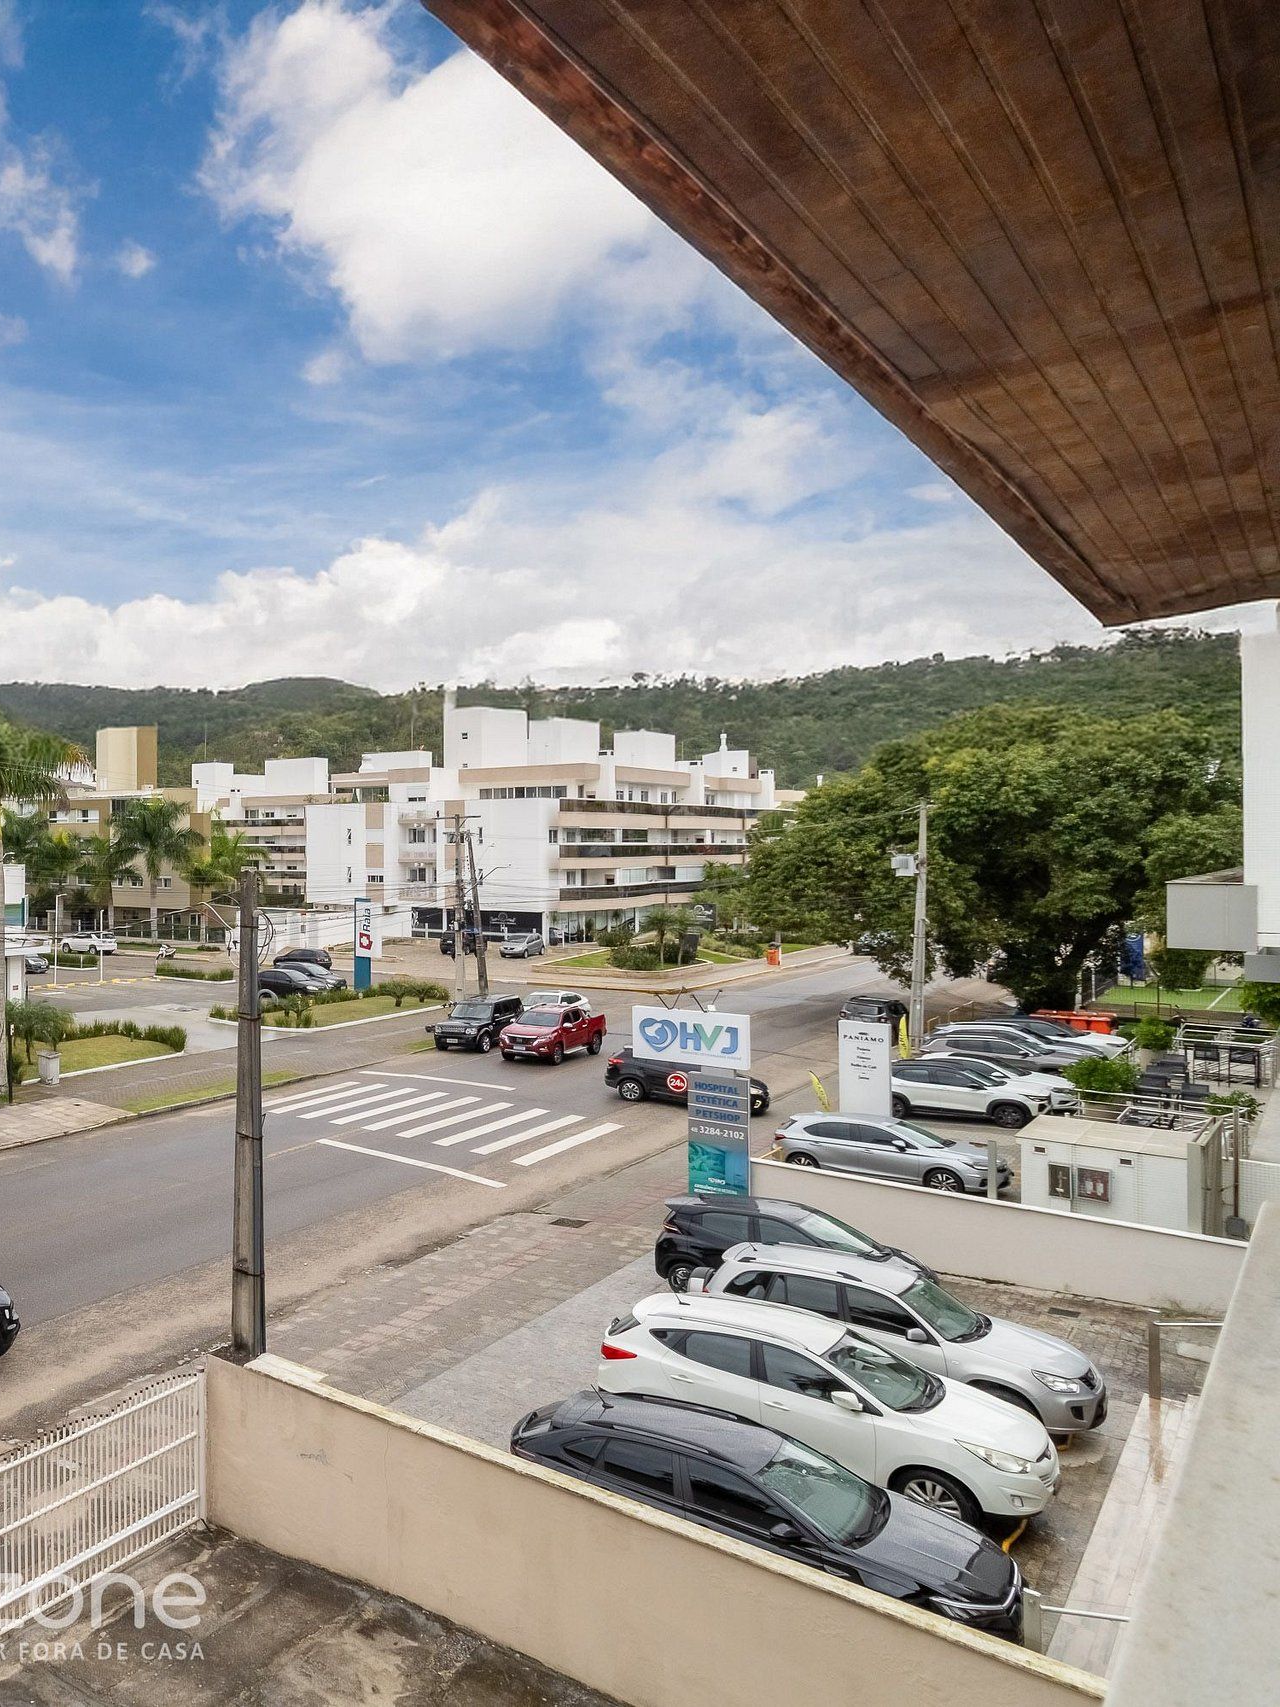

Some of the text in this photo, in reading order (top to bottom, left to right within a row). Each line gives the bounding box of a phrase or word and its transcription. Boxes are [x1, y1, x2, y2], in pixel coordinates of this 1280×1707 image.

[362, 908, 371, 932] Raia
[679, 1021, 739, 1054] HVJ
[843, 1034, 884, 1043] PANIAMO
[694, 1081, 740, 1095] HOSPITAL
[695, 1094, 738, 1108] ESTÉTICA
[695, 1109, 741, 1122] PETSHOP
[699, 1125, 745, 1140] 3284-2102
